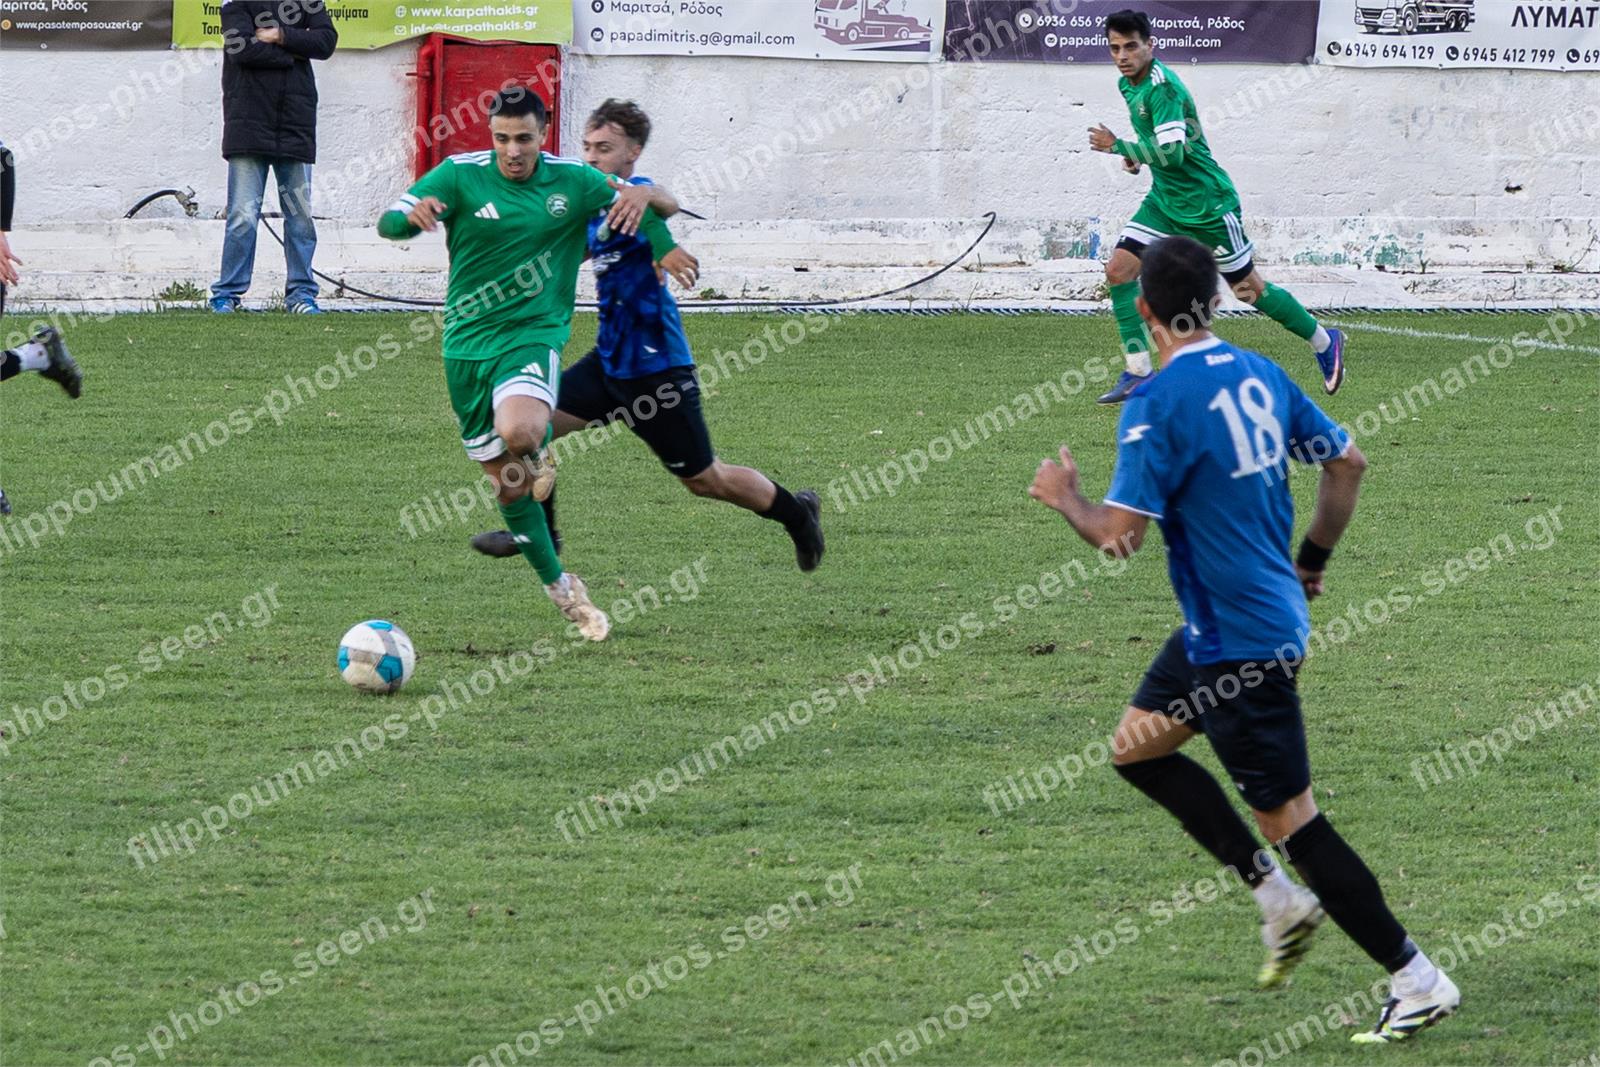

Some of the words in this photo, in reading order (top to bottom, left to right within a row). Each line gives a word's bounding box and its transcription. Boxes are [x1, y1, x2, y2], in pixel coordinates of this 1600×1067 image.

[327, 5, 369, 21] αψίματα
[411, 5, 539, 19] www.karpathakis.gr
[610, 1, 675, 15] Μαριτσά,
[680, 2, 724, 17] Ρόδος
[1037, 16, 1067, 28] 6936
[1070, 16, 1092, 28] 656
[1207, 17, 1246, 31] Ρόδος
[610, 29, 795, 46] papadimitris.g@gmail.com
[1345, 43, 1377, 58] 6949
[1382, 44, 1407, 58] 694
[1412, 46, 1435, 60] 129
[1463, 48, 1497, 62] 6945
[1502, 48, 1526, 63] 412
[1531, 49, 1555, 63] 799
[1208, 377, 1285, 479] 18
